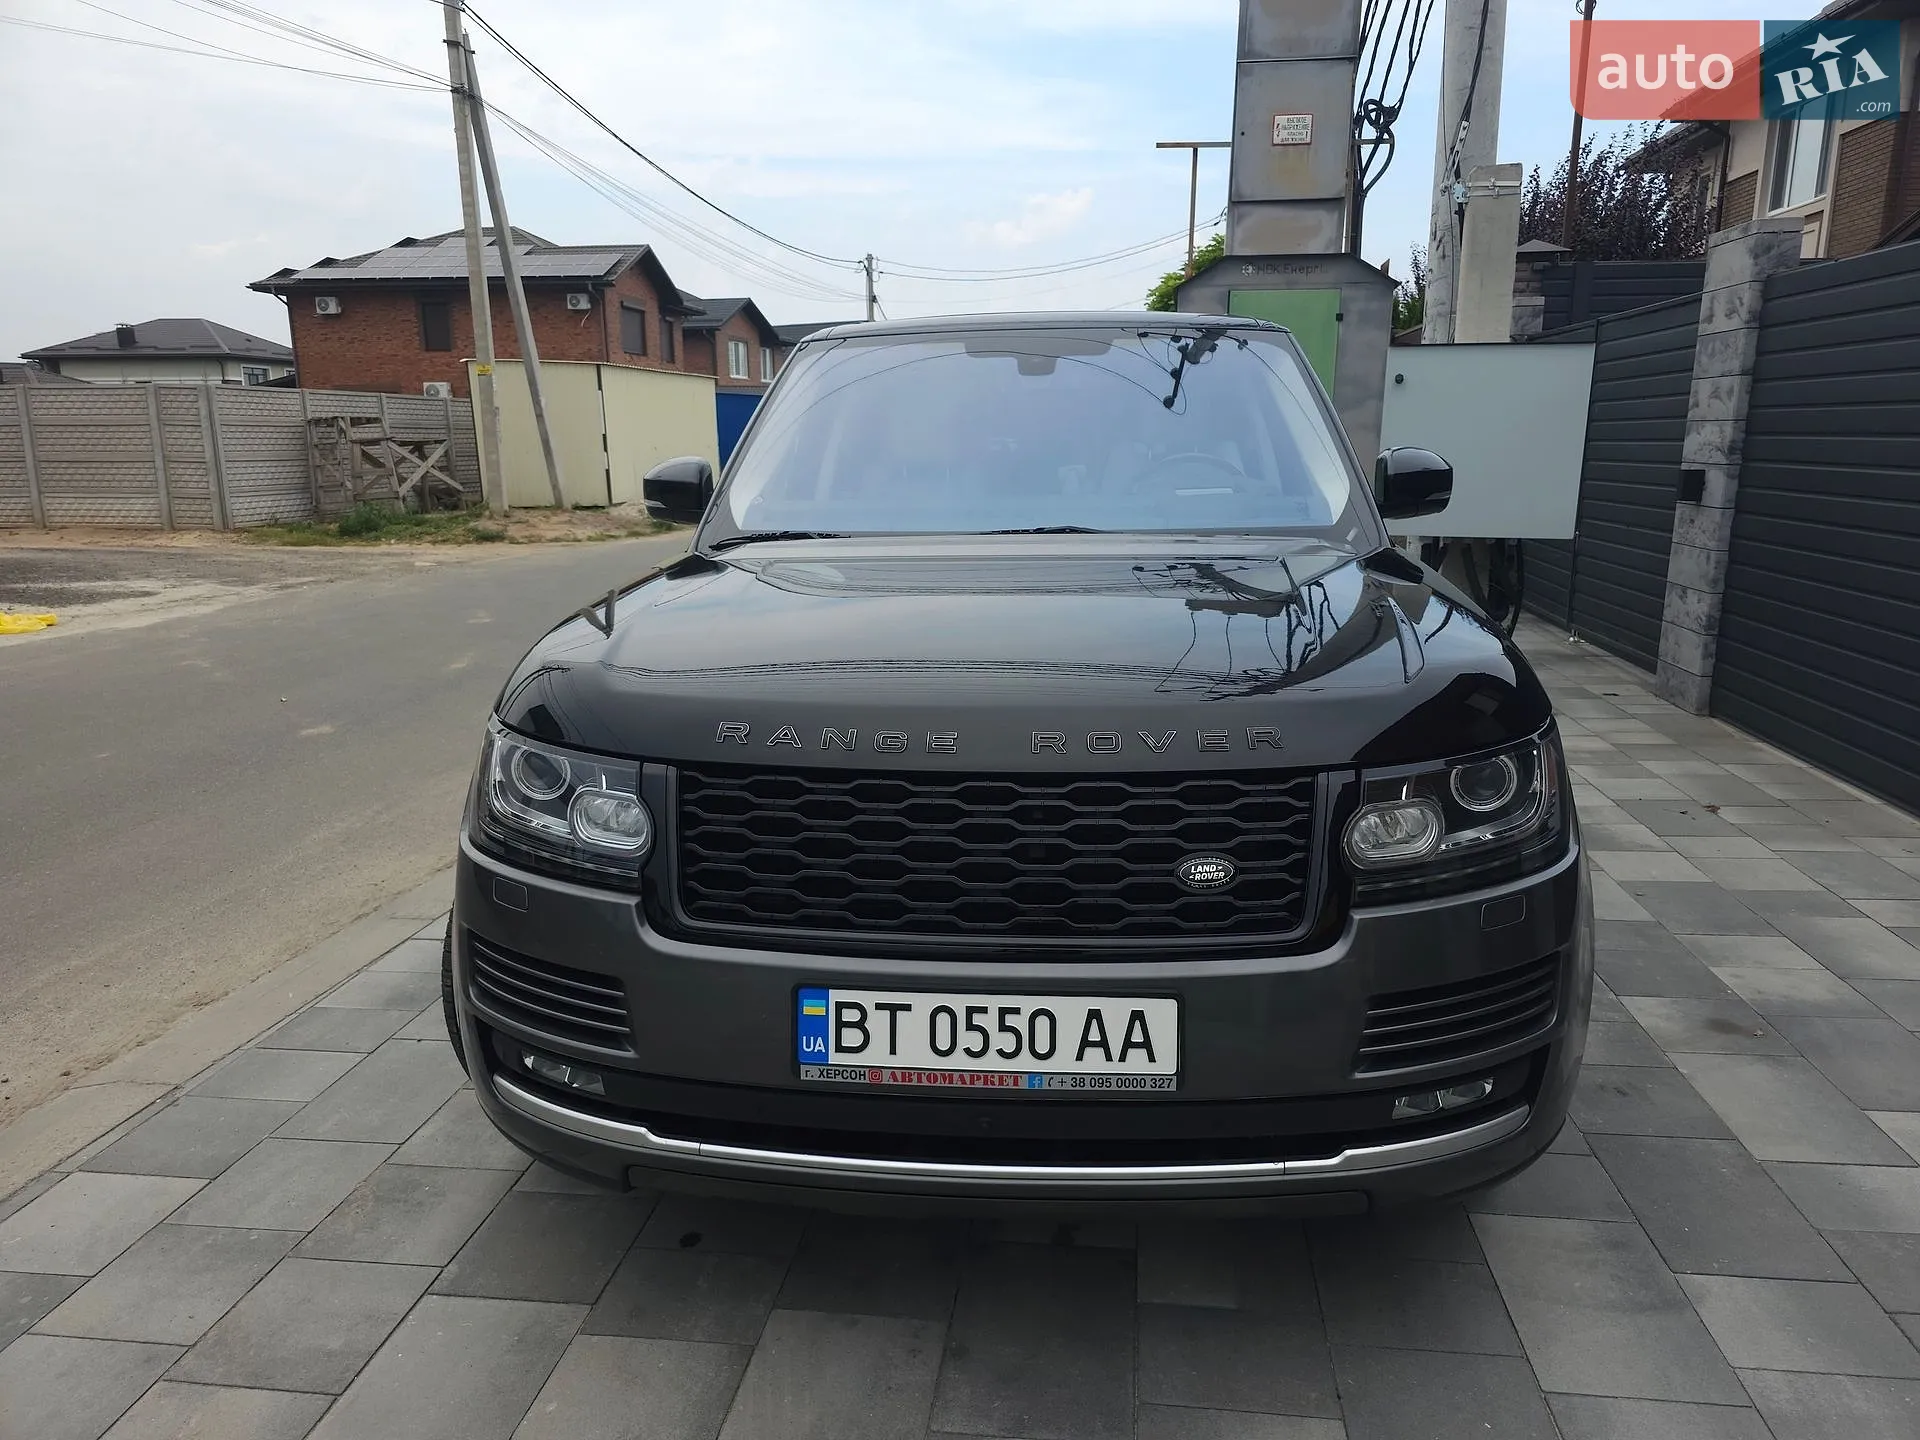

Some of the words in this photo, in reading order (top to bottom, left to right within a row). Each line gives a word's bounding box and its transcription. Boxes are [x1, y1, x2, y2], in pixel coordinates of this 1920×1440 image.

[716, 721, 959, 754] RANGE
[1030, 726, 1284, 755] ROVER
[1190, 864, 1217, 873] LAND
[1194, 871, 1225, 881] ROVER
[834, 1000, 912, 1056] BT
[929, 1004, 1057, 1060] 0550
[1074, 1007, 1157, 1063] AA
[802, 1035, 826, 1054] UA
[817, 1067, 867, 1081] ХЕРСОН
[887, 1070, 1023, 1087] АВТОМАРКЕТ
[1089, 1077, 1112, 1089] 095
[1116, 1077, 1147, 1089] 0000
[1150, 1077, 1173, 1089] 327
